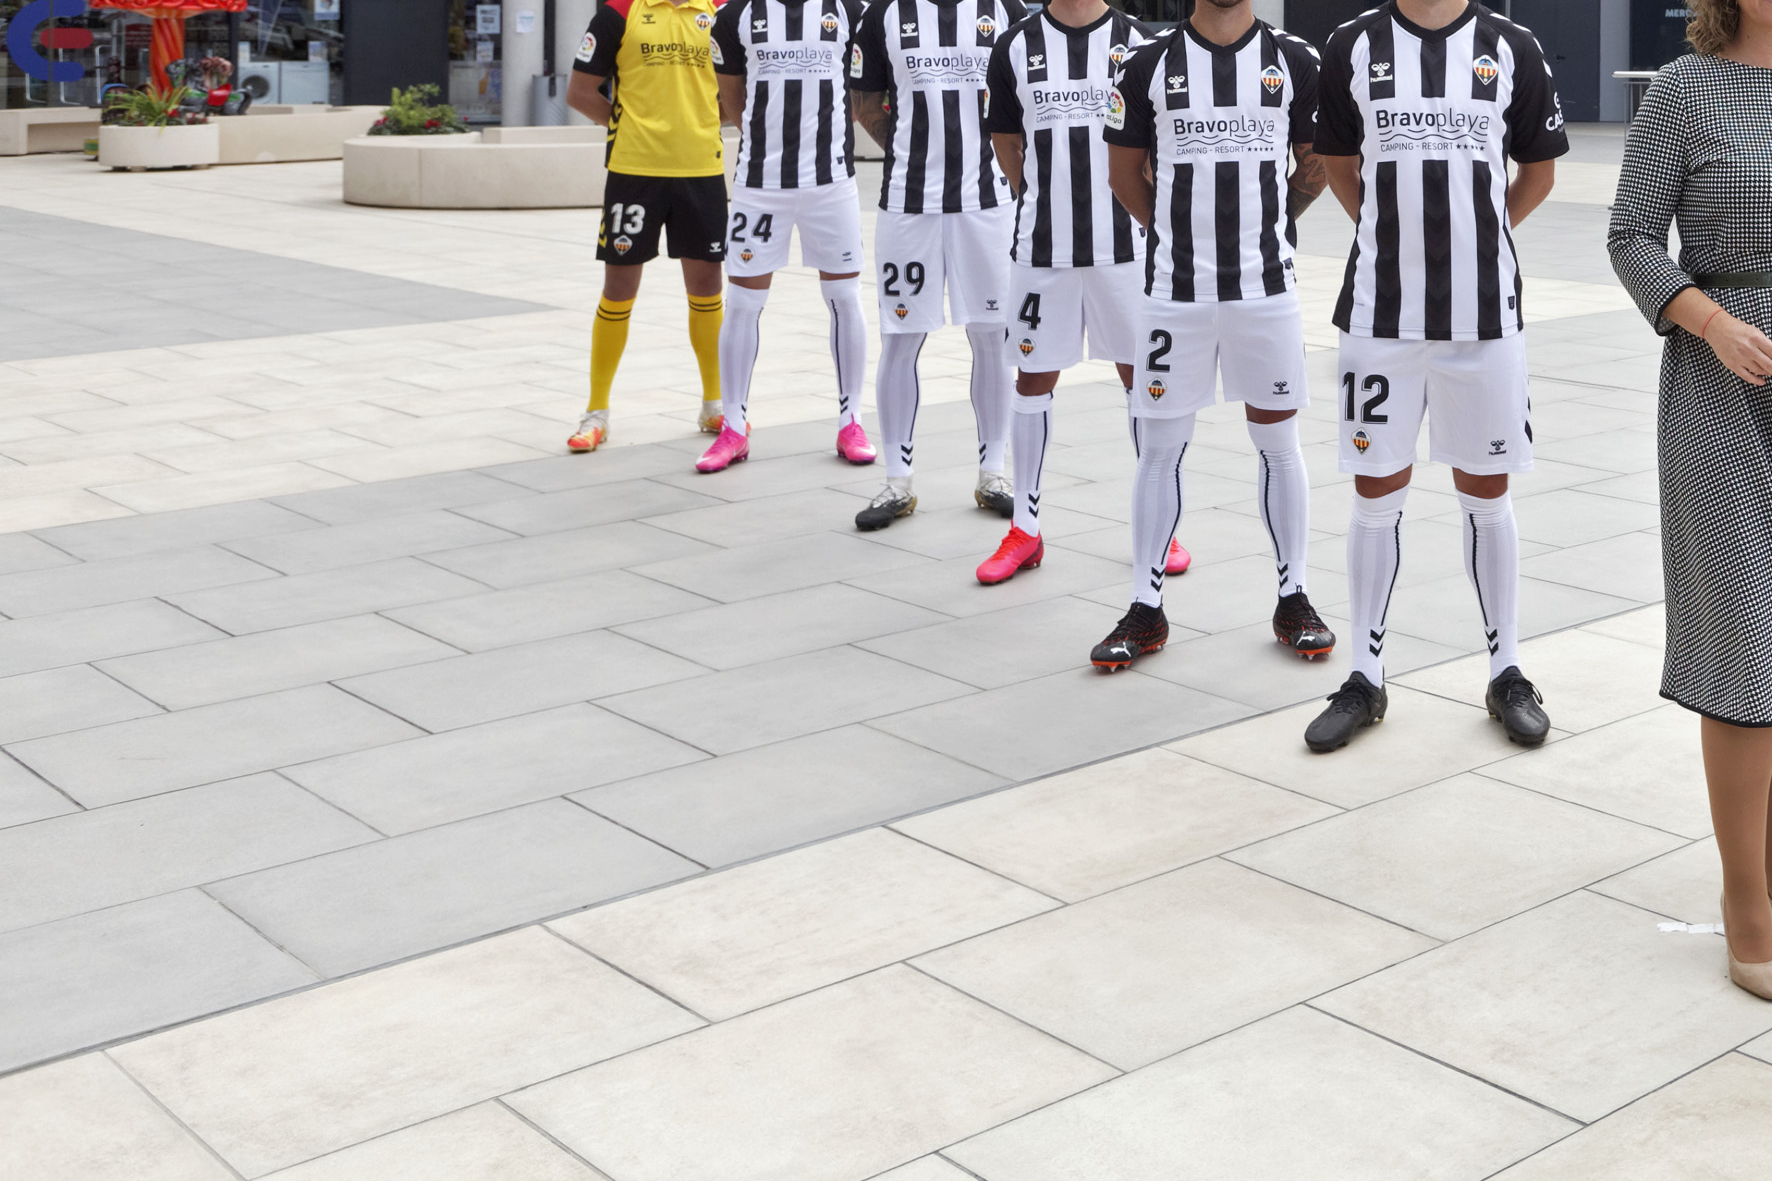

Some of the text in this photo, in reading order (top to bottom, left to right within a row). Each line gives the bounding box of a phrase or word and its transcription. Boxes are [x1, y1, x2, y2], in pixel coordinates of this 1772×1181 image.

[756, 46, 833, 61] Bravoplaya
[1370, 74, 1393, 83] hummel
[1067, 112, 1094, 120] RESORT
[1173, 114, 1275, 138] Bravoplaya
[1375, 107, 1490, 133] Bravoplaya
[1176, 145, 1245, 155] CAMPING RESORT
[1380, 142, 1453, 153] CAMPING RESORT
[610, 202, 646, 235] 13
[730, 211, 773, 243] 24
[883, 261, 925, 296] 29
[1017, 292, 1041, 330] 4
[1146, 328, 1173, 373] 2
[1341, 371, 1390, 425] 12
[1488, 449, 1507, 457] hummel
